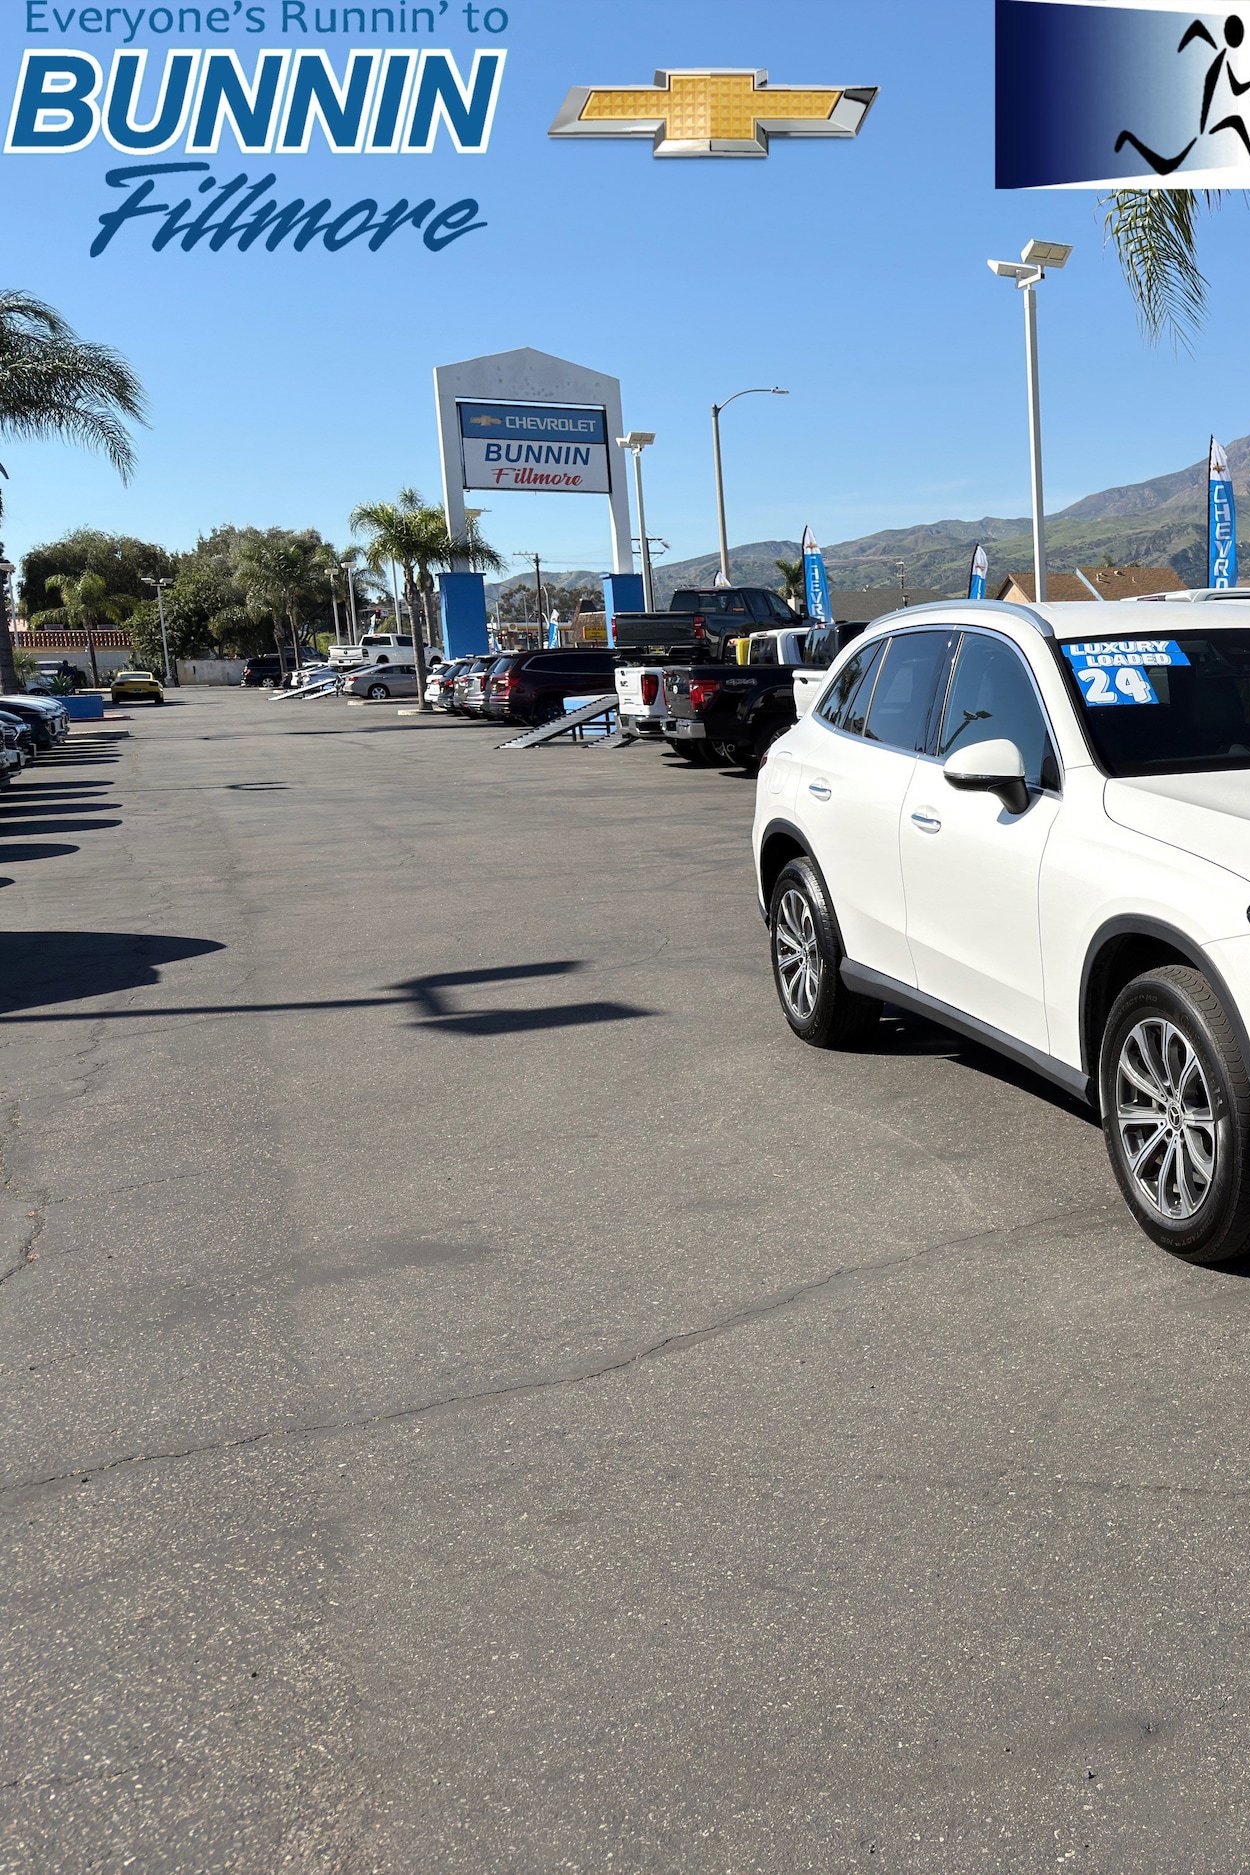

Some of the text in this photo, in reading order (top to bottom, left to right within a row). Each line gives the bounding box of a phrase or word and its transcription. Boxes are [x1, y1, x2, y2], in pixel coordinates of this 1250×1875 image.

[505, 416, 596, 432] CHEVROLET
[484, 443, 591, 466] BUNNIN
[491, 467, 583, 487] Fillmore
[1069, 641, 1170, 656] LUXURY
[1085, 653, 1172, 667] LOADED
[1077, 667, 1152, 703] 24
